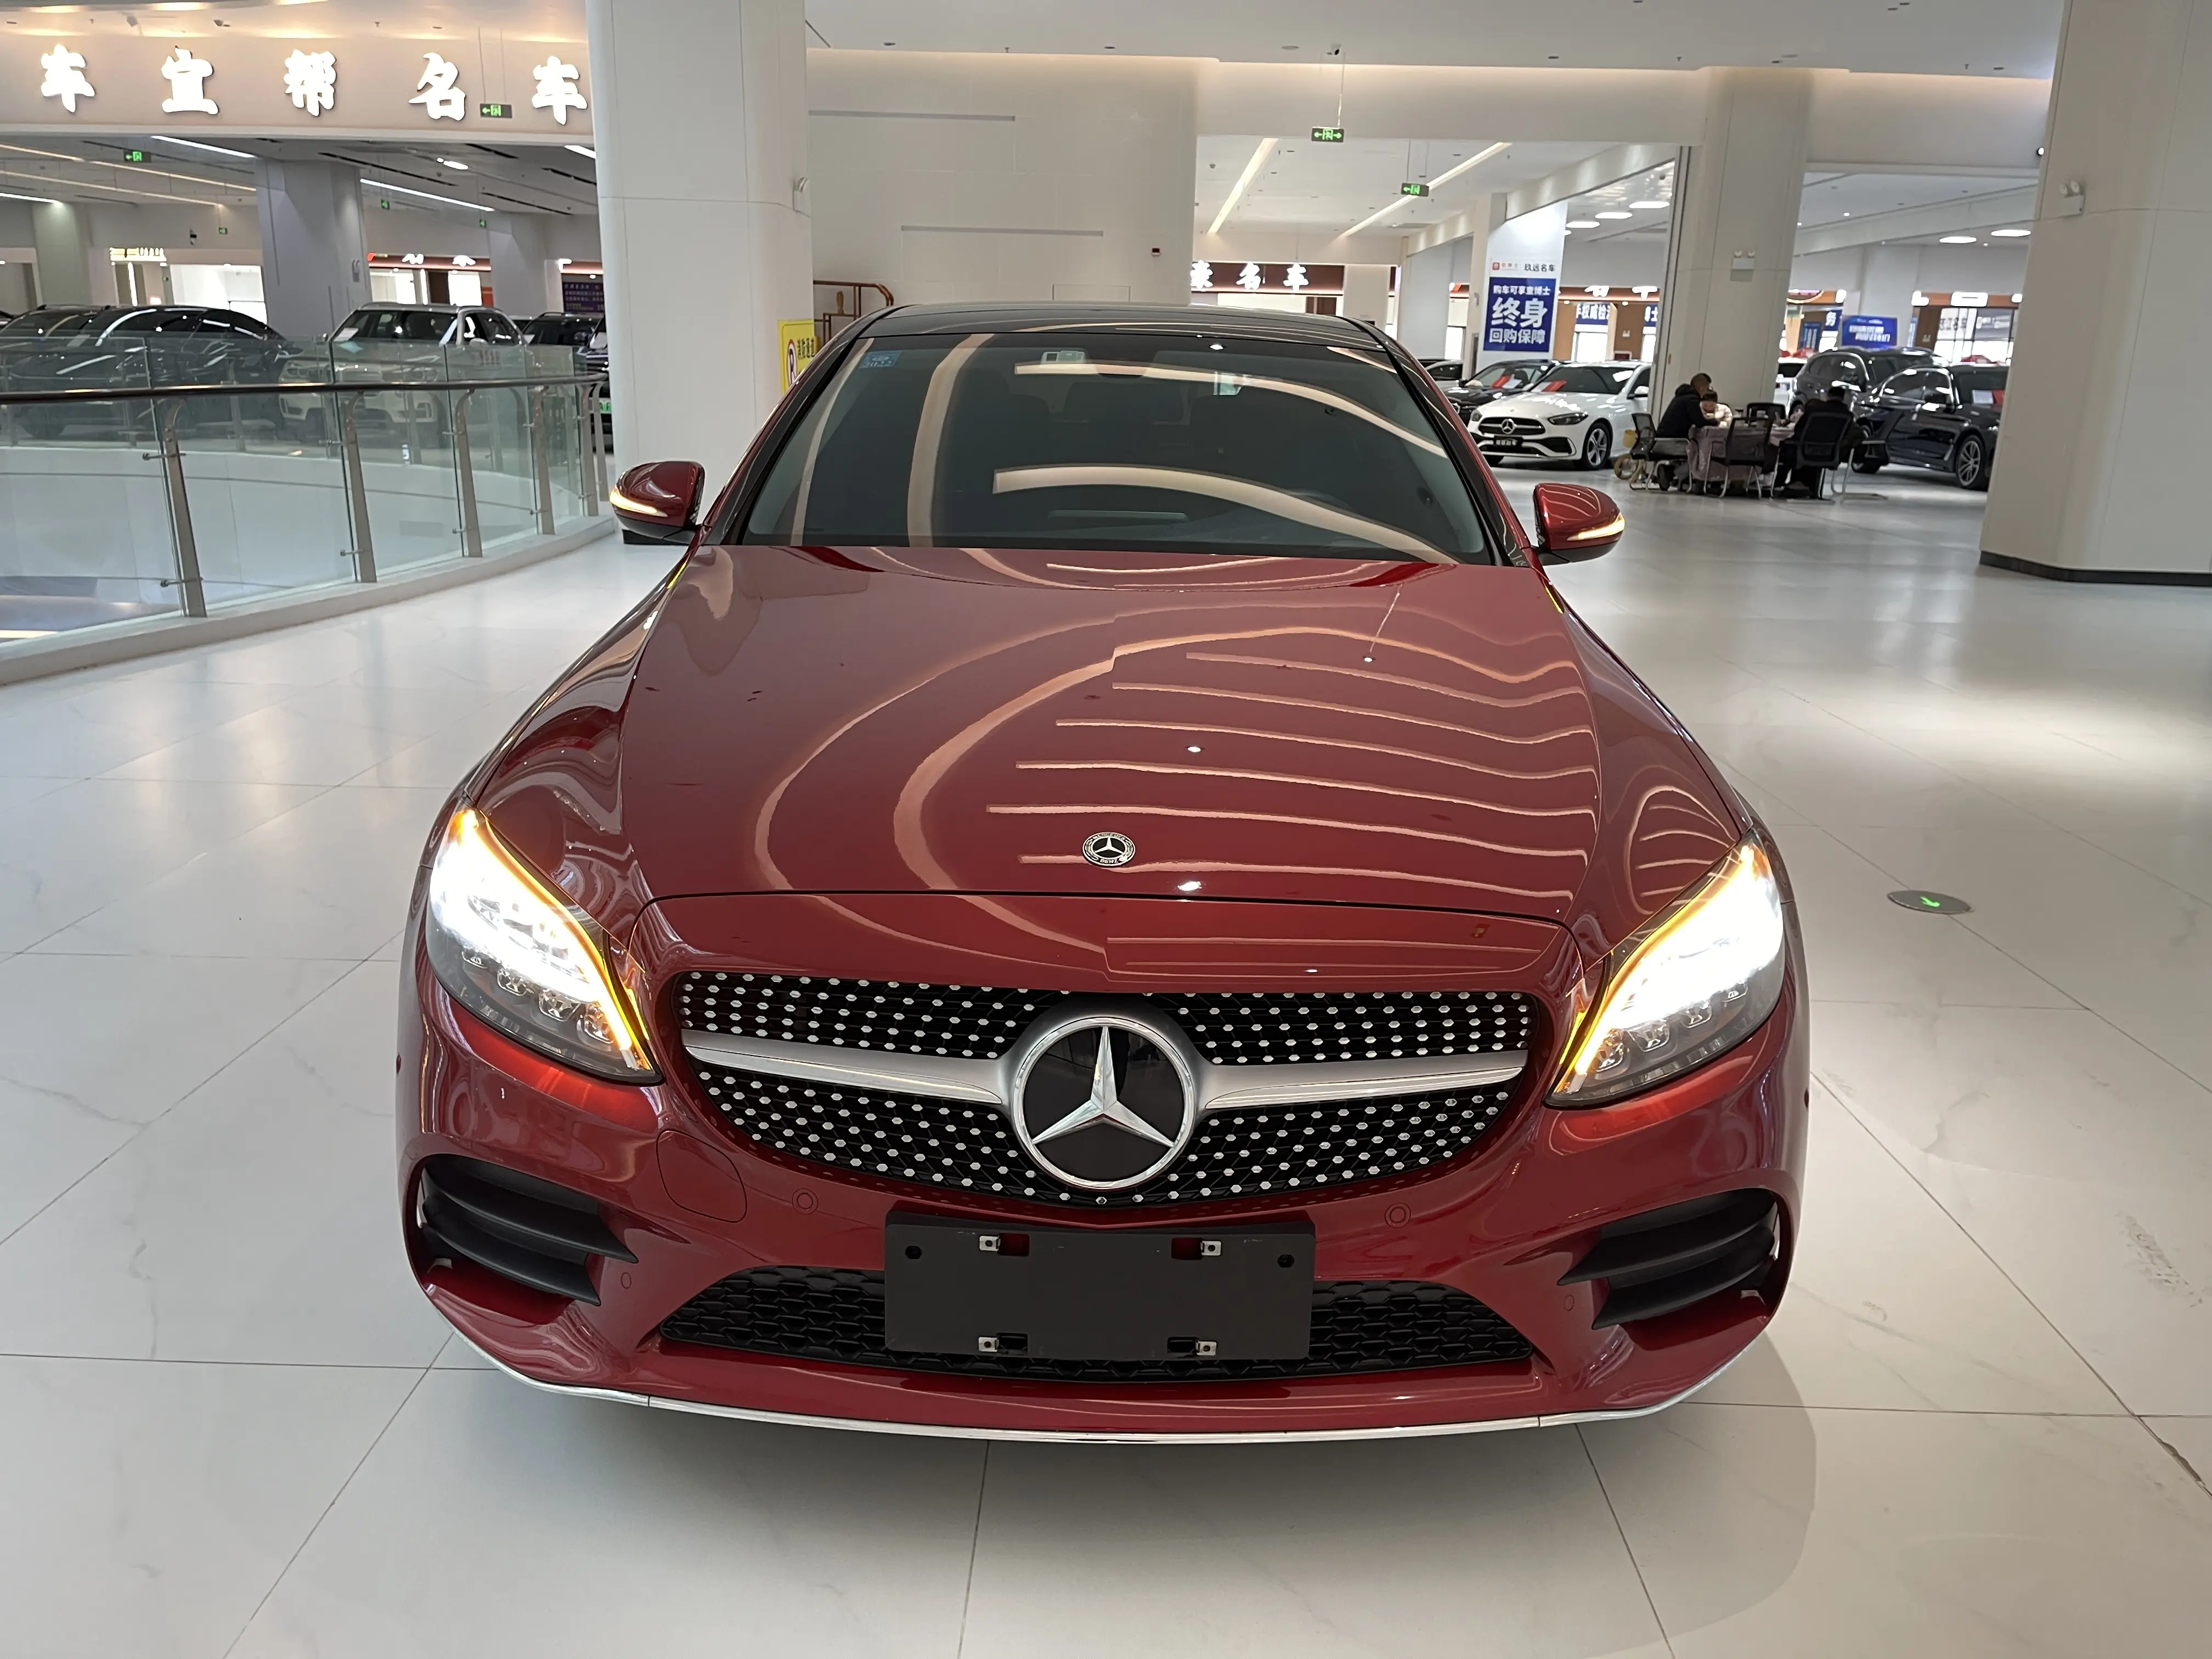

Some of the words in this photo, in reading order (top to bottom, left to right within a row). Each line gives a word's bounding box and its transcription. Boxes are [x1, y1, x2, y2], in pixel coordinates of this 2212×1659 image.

[1491, 297, 1548, 328] 终身
[1489, 328, 1546, 345] 回购保障
